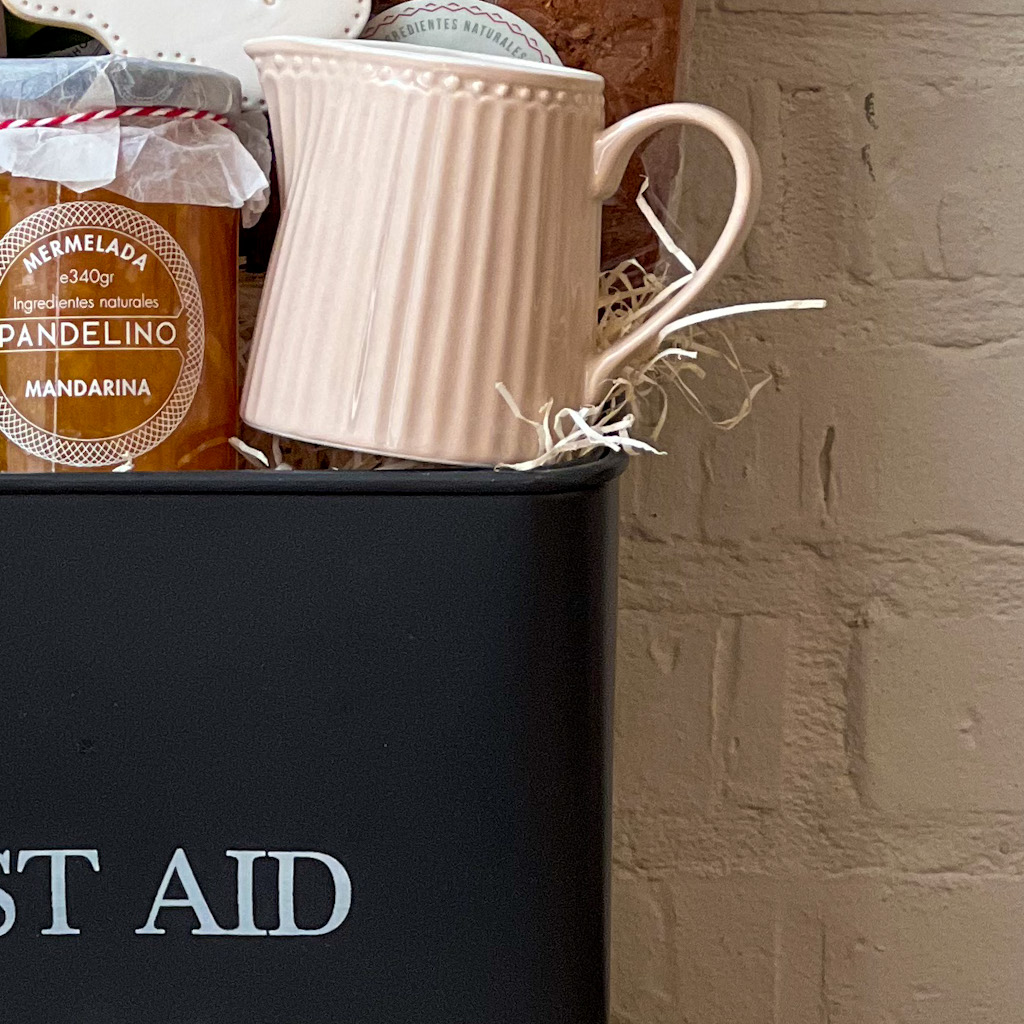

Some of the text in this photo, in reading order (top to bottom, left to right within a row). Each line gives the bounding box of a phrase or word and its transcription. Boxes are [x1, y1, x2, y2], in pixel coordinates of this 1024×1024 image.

[22, 233, 148, 273] MERMELADA
[13, 293, 160, 314] Ingredientes naturales
[25, 379, 151, 398] MANDARINA
[135, 848, 353, 936] AID
